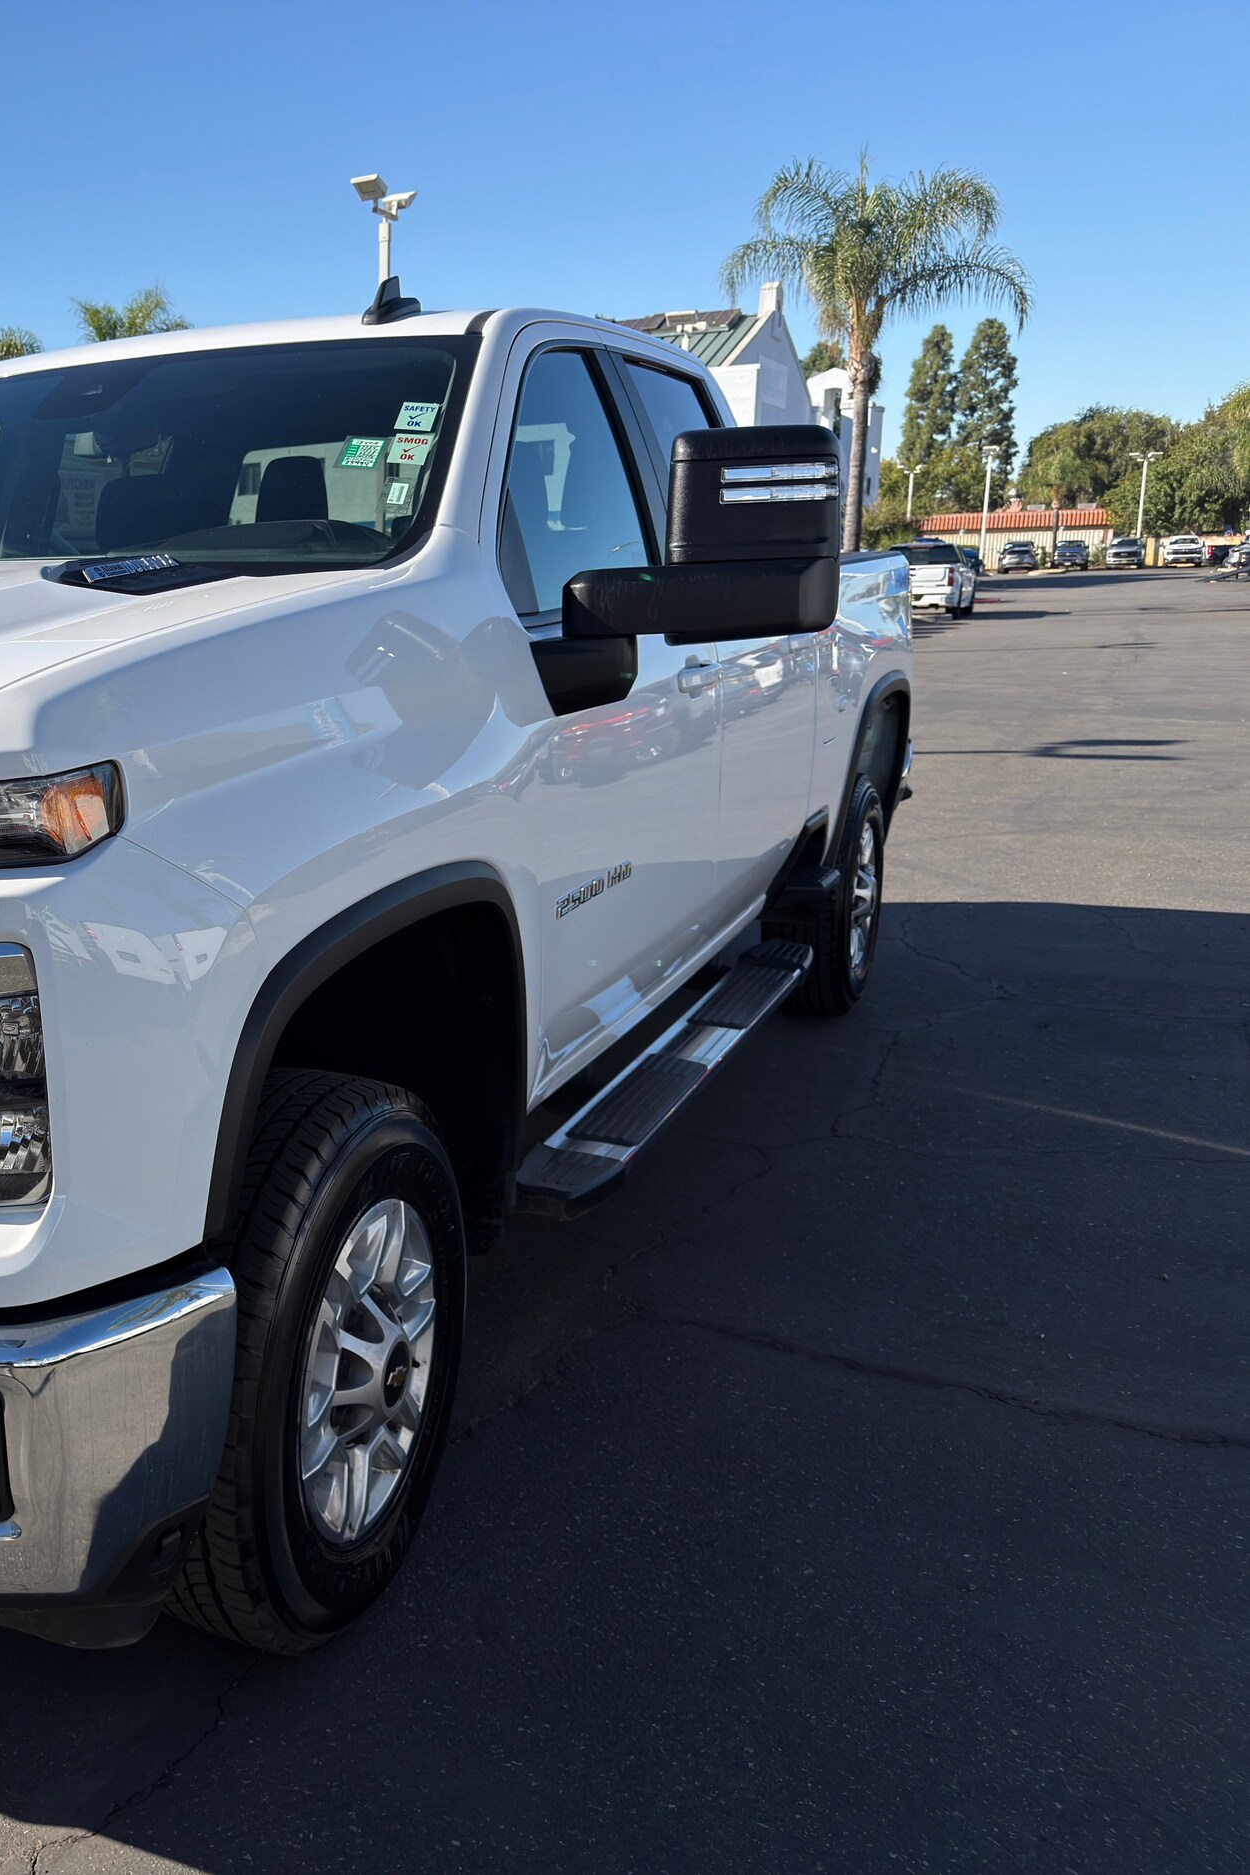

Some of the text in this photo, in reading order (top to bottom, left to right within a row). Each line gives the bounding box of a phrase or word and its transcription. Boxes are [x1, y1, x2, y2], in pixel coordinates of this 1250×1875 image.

[403, 405, 436, 413] SAFETY
[406, 420, 422, 428] OK
[396, 437, 429, 445] SMOG
[399, 453, 415, 461] OK
[556, 860, 633, 919] 2500 HD
